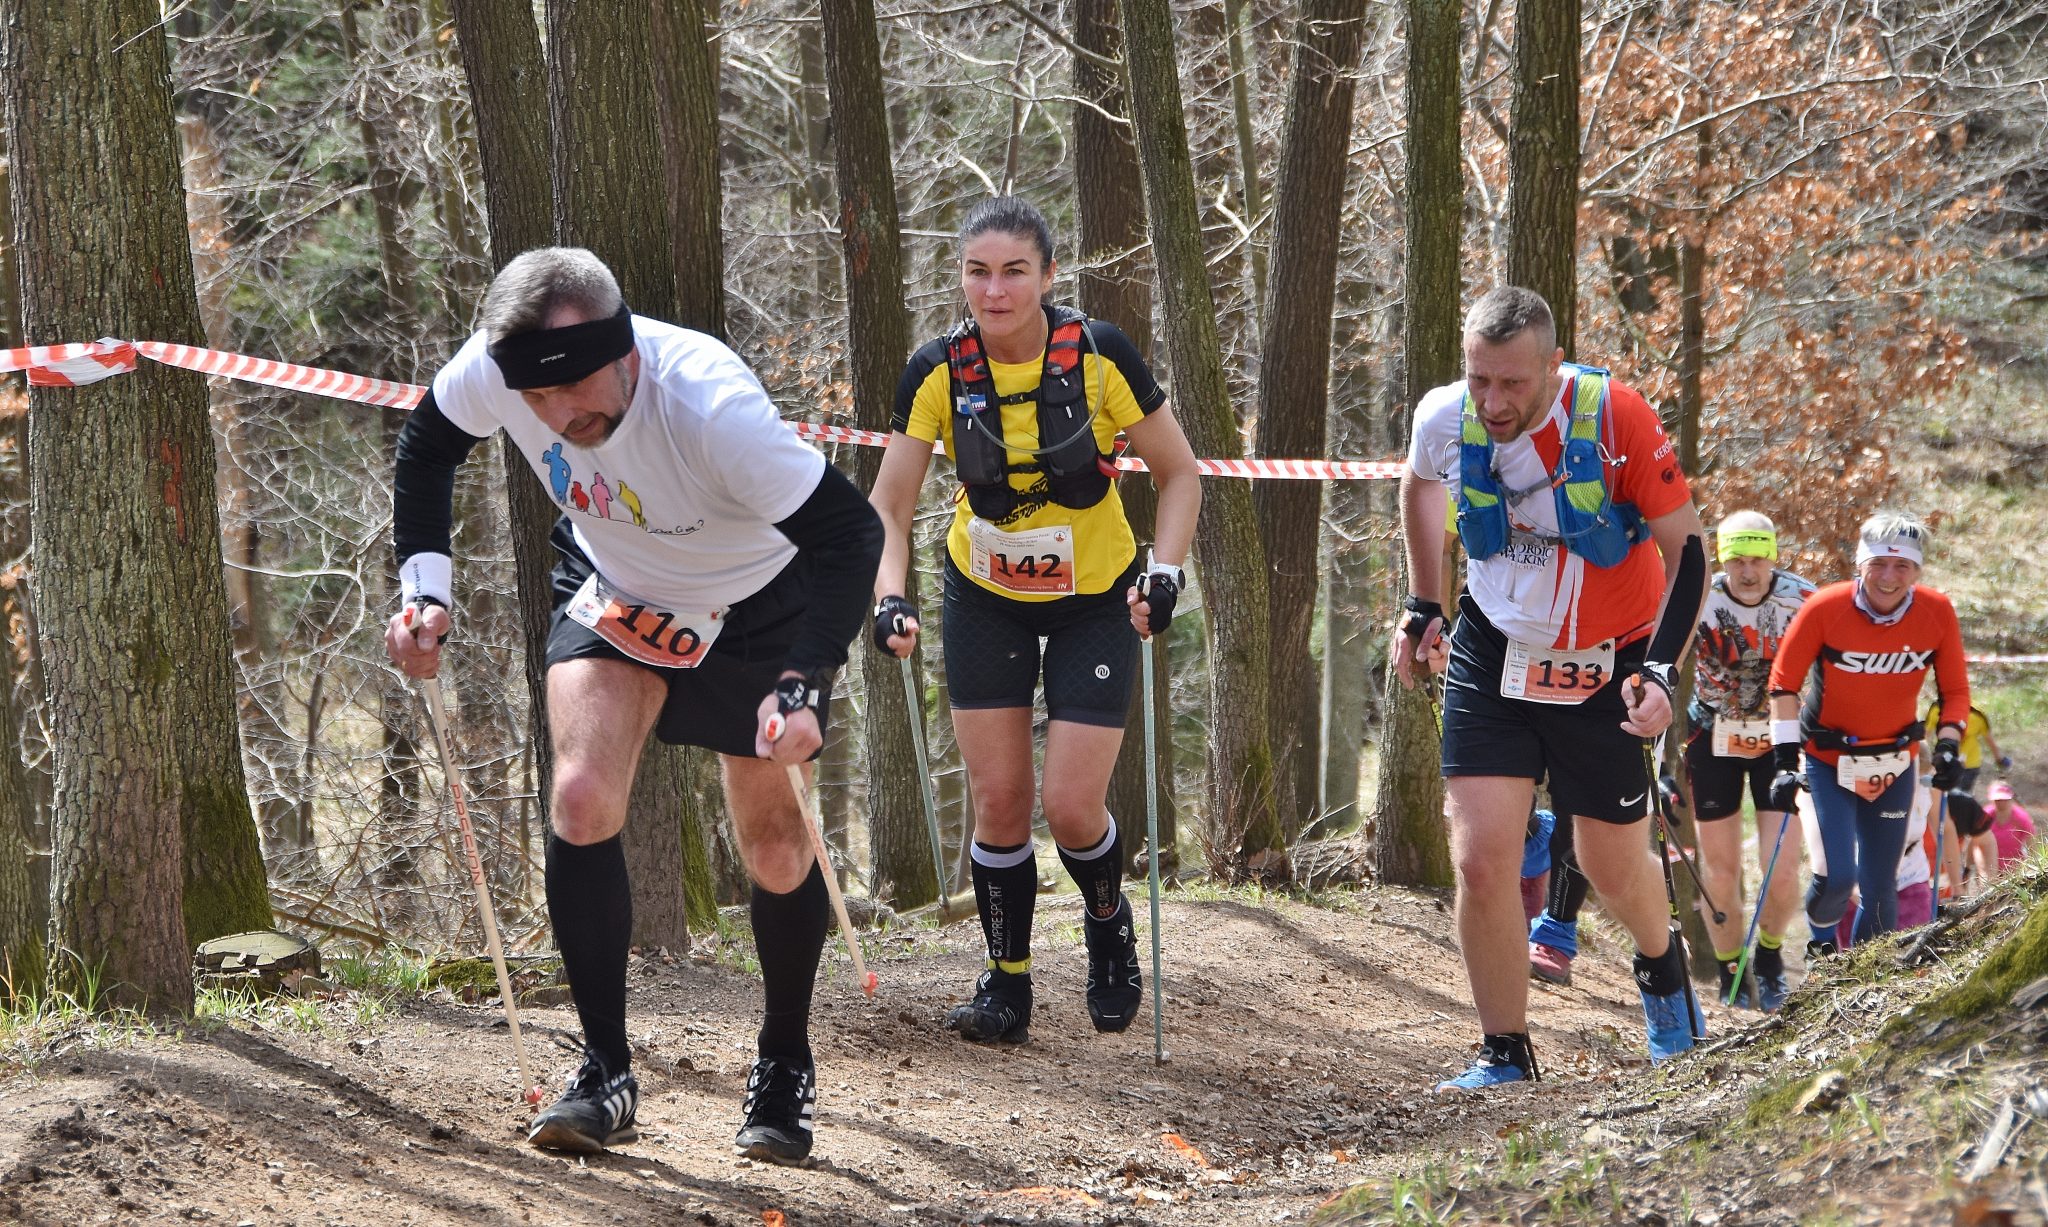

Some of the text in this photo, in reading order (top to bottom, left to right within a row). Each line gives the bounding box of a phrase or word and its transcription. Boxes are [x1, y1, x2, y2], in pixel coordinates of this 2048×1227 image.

[1507, 543, 1554, 558] NORDIC
[995, 553, 1063, 579] 142
[616, 603, 701, 657] 110
[1536, 659, 1604, 690] 133
[1734, 732, 1771, 751] 195
[1869, 771, 1899, 794] 90
